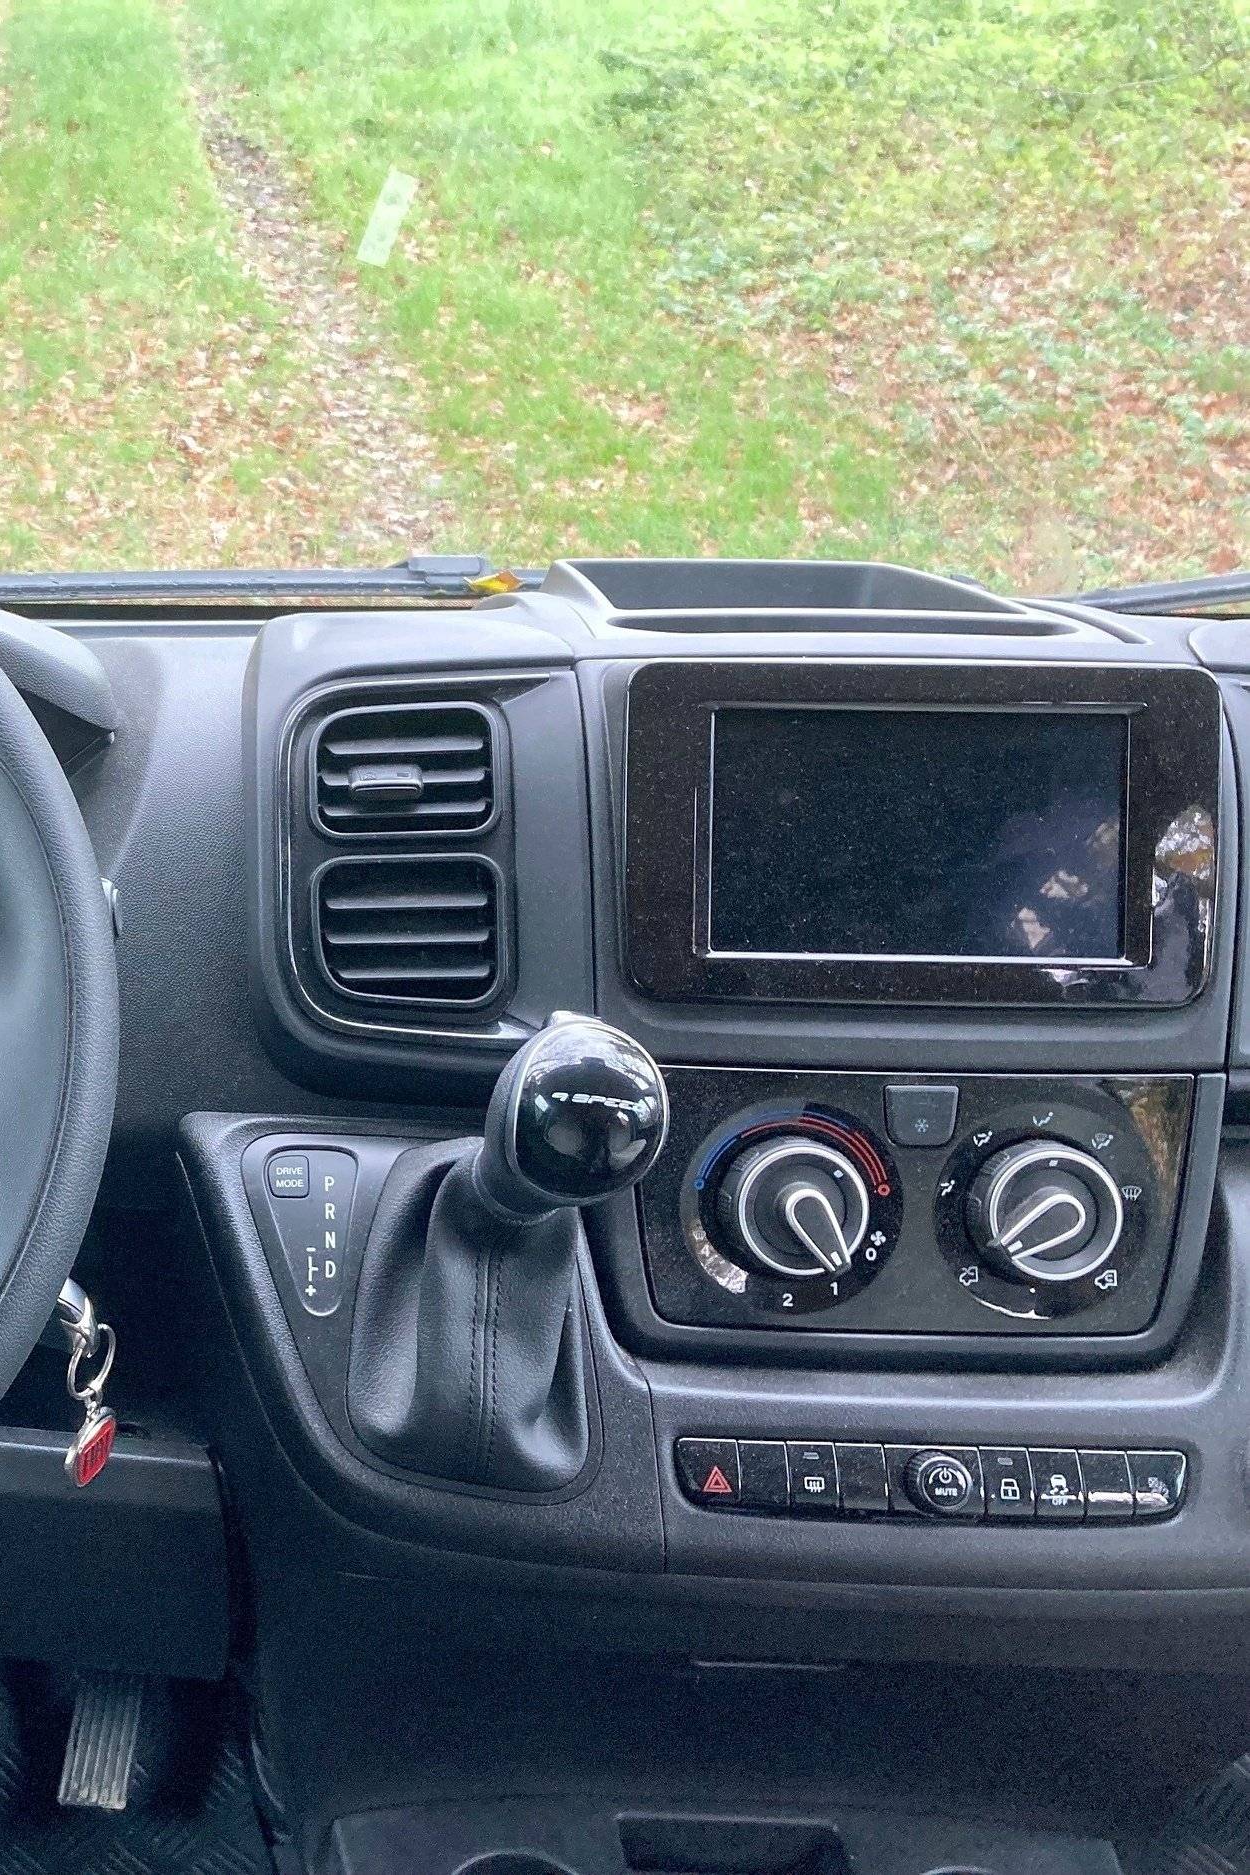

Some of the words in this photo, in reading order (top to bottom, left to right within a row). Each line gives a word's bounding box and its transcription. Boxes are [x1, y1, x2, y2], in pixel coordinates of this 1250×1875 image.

[276, 1166, 303, 1176] DRIVE
[276, 1179, 304, 1188] MODE
[324, 1175, 335, 1192] P
[324, 1202, 336, 1220] R
[325, 1231, 336, 1249] N
[865, 1247, 877, 1261] 0
[325, 1260, 337, 1278] D
[830, 1281, 839, 1296] 1
[782, 1293, 794, 1307] 2
[934, 1487, 958, 1497] MUTE
[1051, 1497, 1068, 1506] OFF
